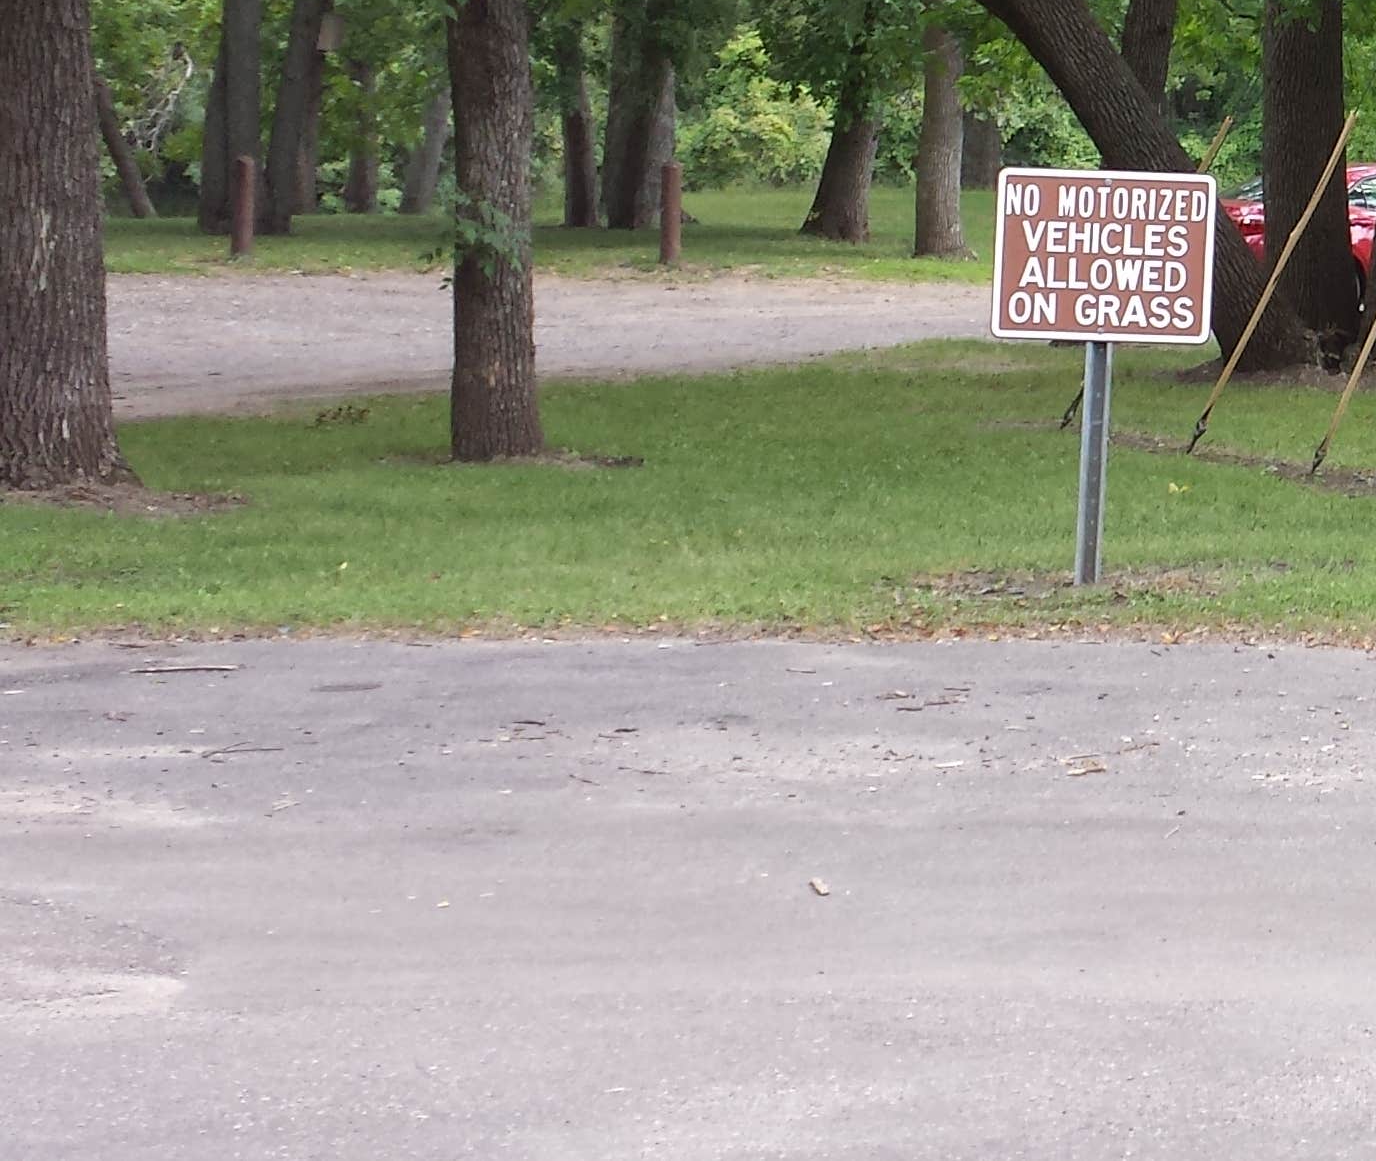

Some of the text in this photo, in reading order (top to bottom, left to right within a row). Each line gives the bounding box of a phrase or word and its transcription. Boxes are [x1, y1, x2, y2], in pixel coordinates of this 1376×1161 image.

[1006, 183, 1207, 222] NO MOTORIZED
[1022, 220, 1189, 257] VEHICLES
[1019, 256, 1187, 292] ALLOWED
[1008, 291, 1195, 329] ON GRASS
